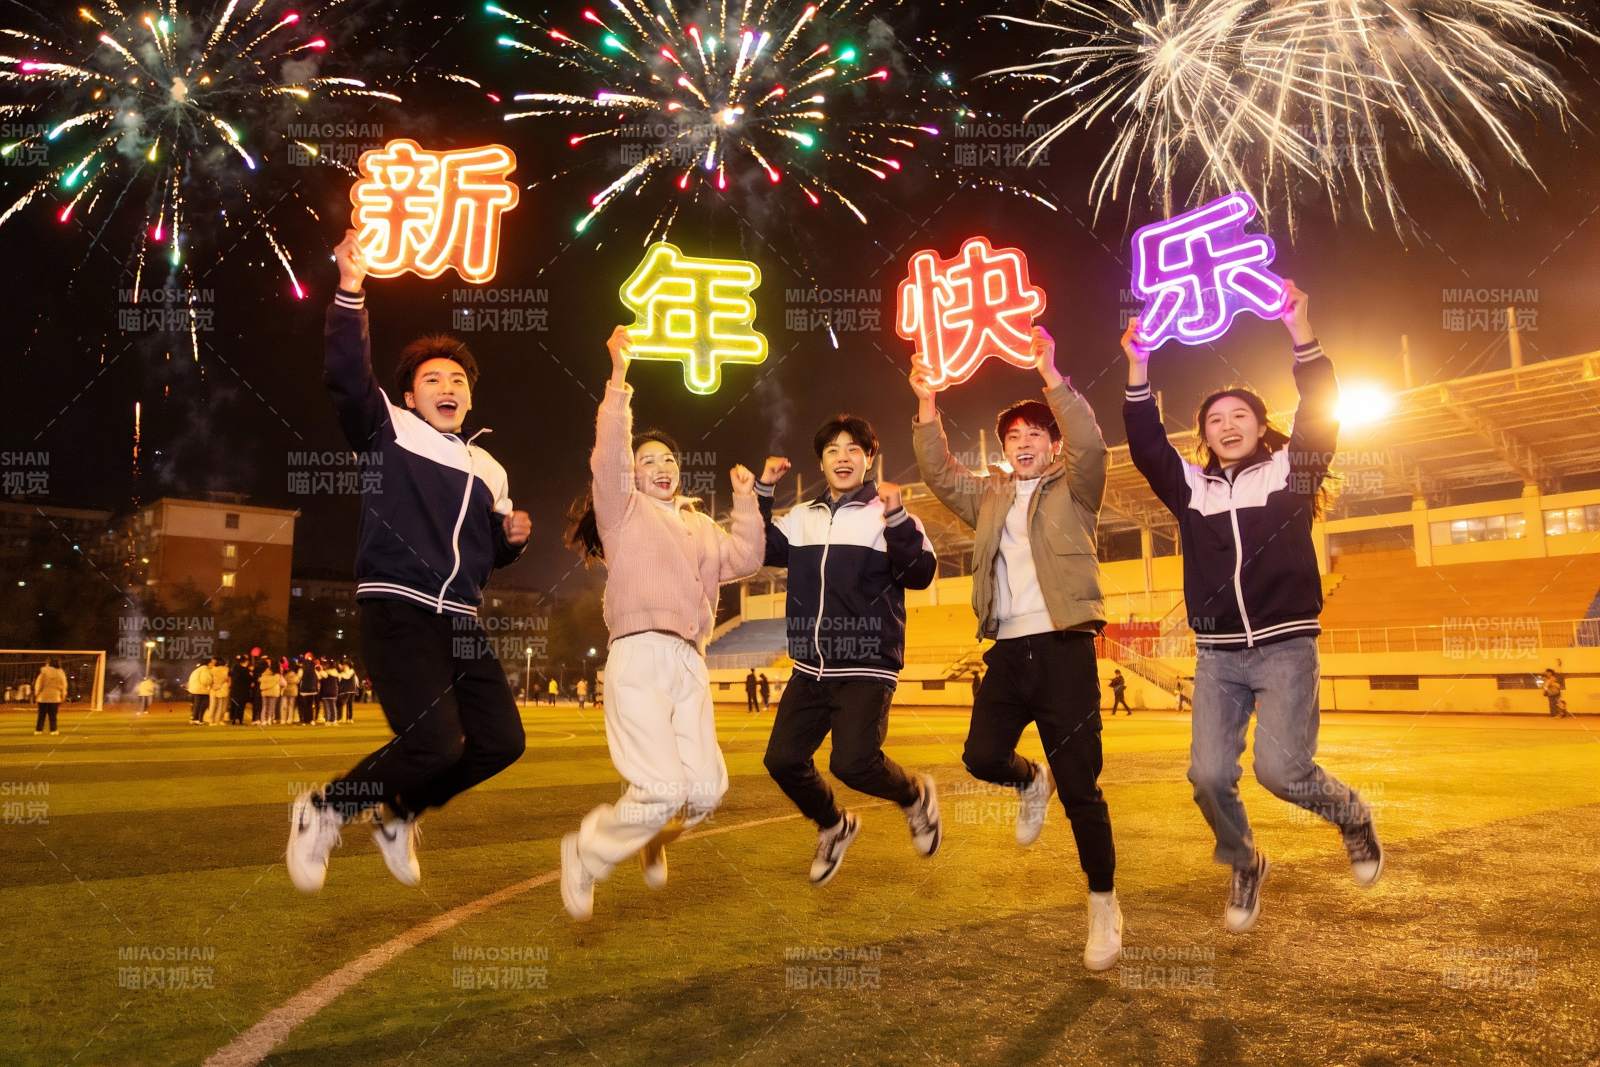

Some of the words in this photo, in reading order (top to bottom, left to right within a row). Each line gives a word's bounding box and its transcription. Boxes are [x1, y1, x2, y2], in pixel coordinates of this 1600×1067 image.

[358, 142, 513, 275] 新
[1138, 196, 1283, 341] 乐
[626, 246, 763, 386] 年
[902, 241, 1040, 385] 快
